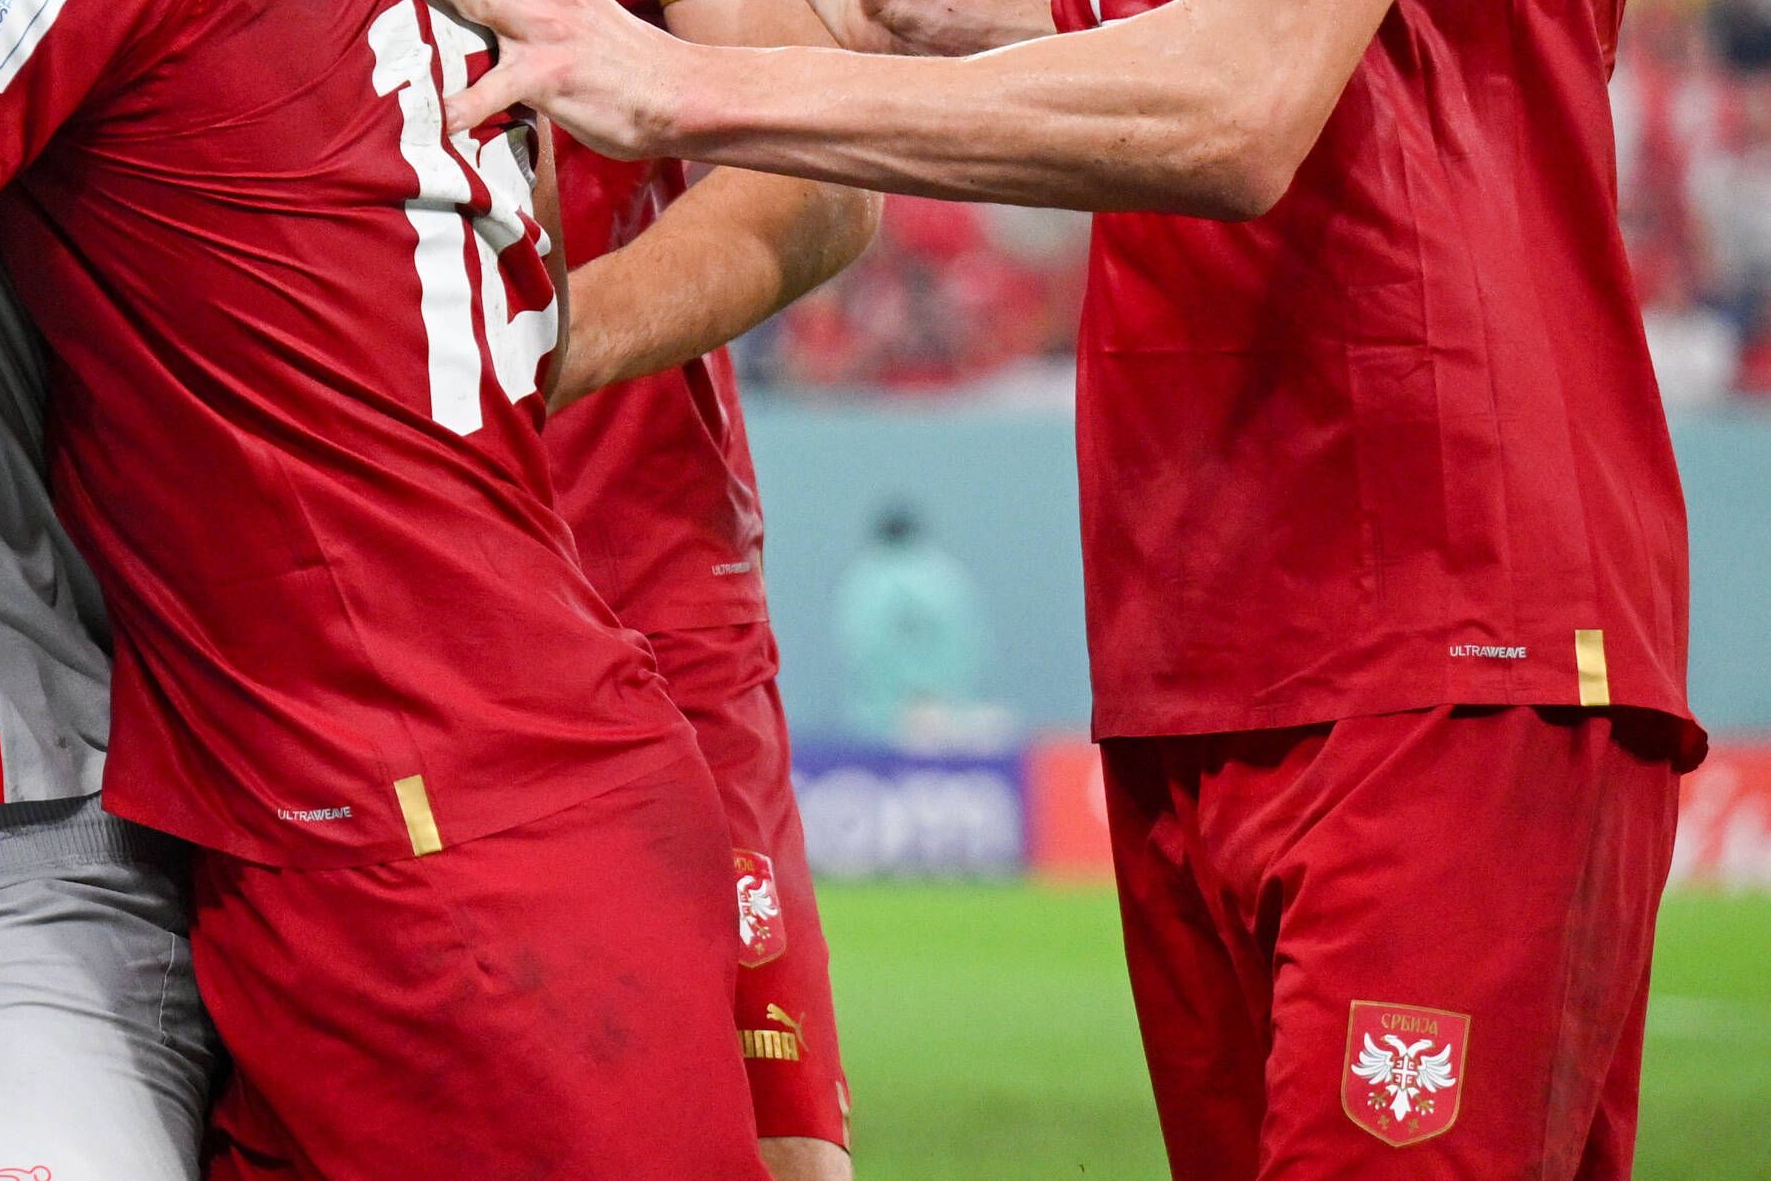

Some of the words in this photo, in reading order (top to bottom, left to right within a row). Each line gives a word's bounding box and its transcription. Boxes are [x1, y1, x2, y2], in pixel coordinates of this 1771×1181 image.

[1449, 645, 1526, 659] ULTRAWEAVE
[277, 805, 353, 822] ULTRAWEAVE
[1381, 1013, 1439, 1036] СРБИЈА
[738, 1030, 800, 1061] UMA
